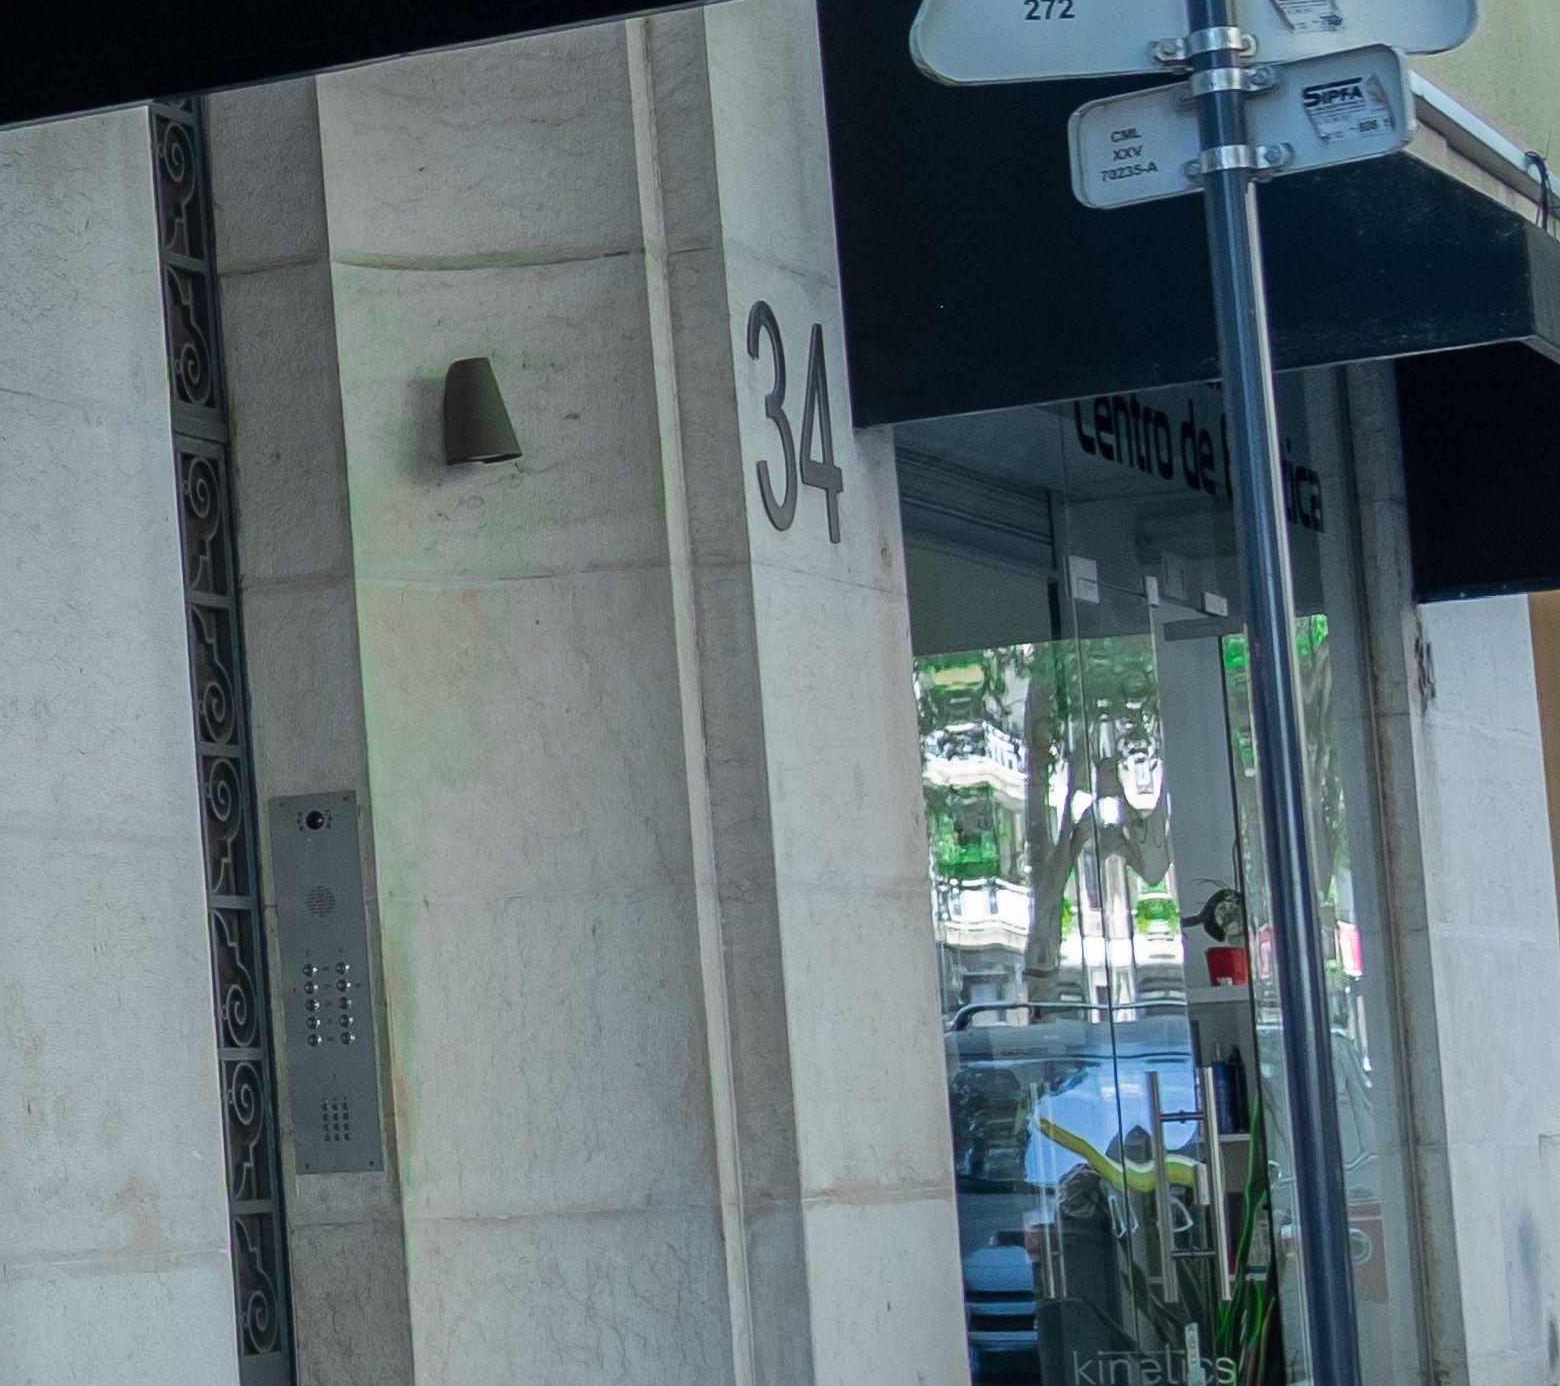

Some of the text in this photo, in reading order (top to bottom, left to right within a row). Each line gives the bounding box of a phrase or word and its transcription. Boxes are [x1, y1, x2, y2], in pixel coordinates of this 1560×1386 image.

[1110, 127, 1143, 143] CML
[745, 299, 845, 545] 34
[1180, 398, 1217, 496] de
